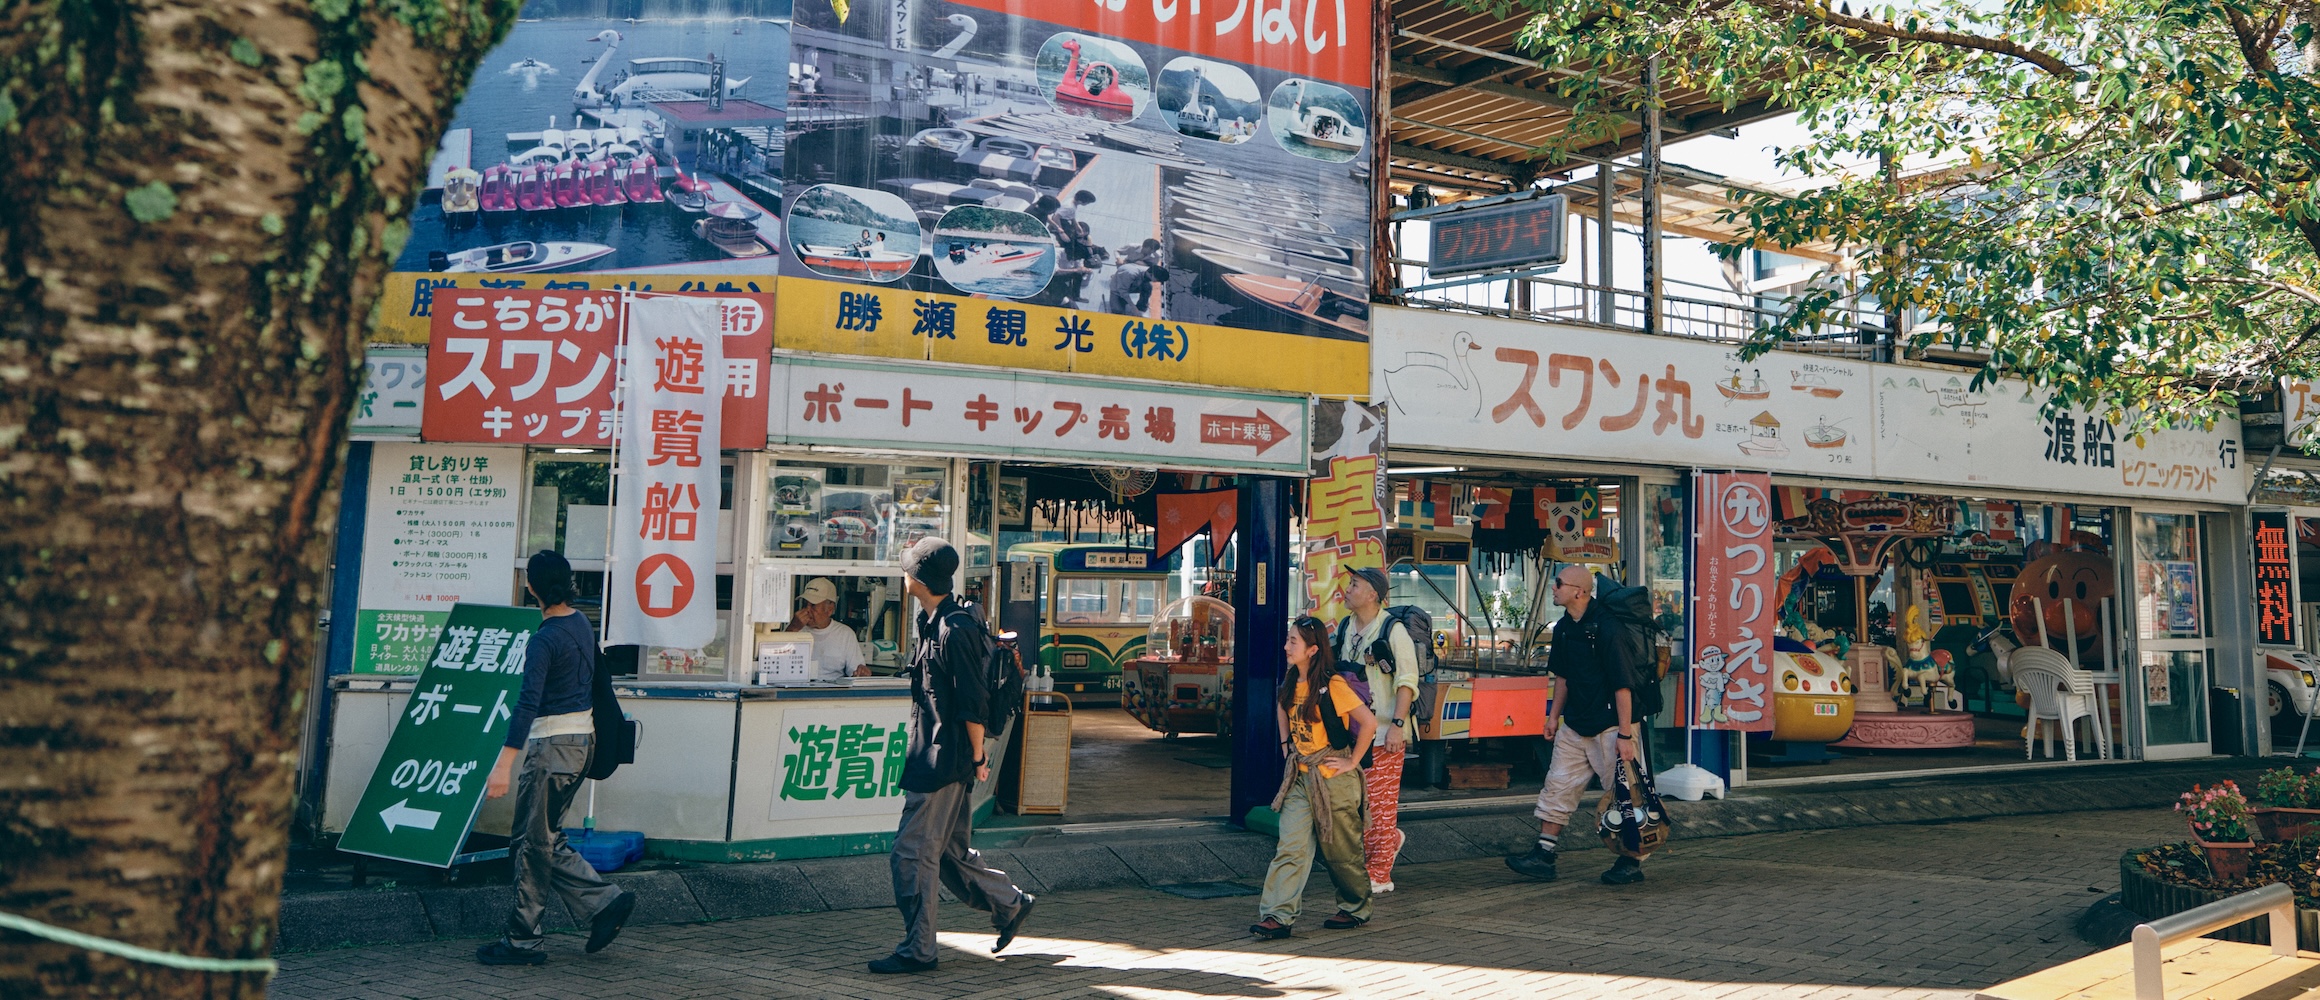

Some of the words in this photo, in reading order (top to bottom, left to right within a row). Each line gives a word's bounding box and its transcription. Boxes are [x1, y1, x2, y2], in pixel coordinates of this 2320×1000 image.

[710, 63, 721, 107] スワン丸
[1438, 209, 1552, 259] ワカサギ
[453, 295, 615, 333] こちらが
[836, 290, 1189, 362] 勝瀬観光(株)
[439, 338, 628, 404] スワン
[1492, 347, 1704, 439] スワン丸
[803, 382, 933, 428] ボート
[964, 394, 1176, 443] キップ売場
[1207, 421, 1272, 443] ボート乗場
[640, 336, 705, 542] 遊覧船
[2044, 412, 2117, 468] 渡船
[2219, 439, 2238, 469] 行
[410, 455, 489, 472] 貸し釣り竿
[1376, 452, 1386, 500] TENNIS
[2122, 459, 2218, 493] ピクニックランド
[389, 487, 405, 496] 1日
[437, 594, 460, 602] 1000円
[2255, 520, 2292, 640] 無料
[403, 645, 419, 653] 大人
[1725, 543, 1768, 723] つりえさ
[370, 652, 398, 660] ナイター
[402, 653, 418, 661] 大人
[375, 663, 419, 672] 道具レンタル
[410, 684, 511, 733] ボート
[390, 757, 477, 796] のりば
